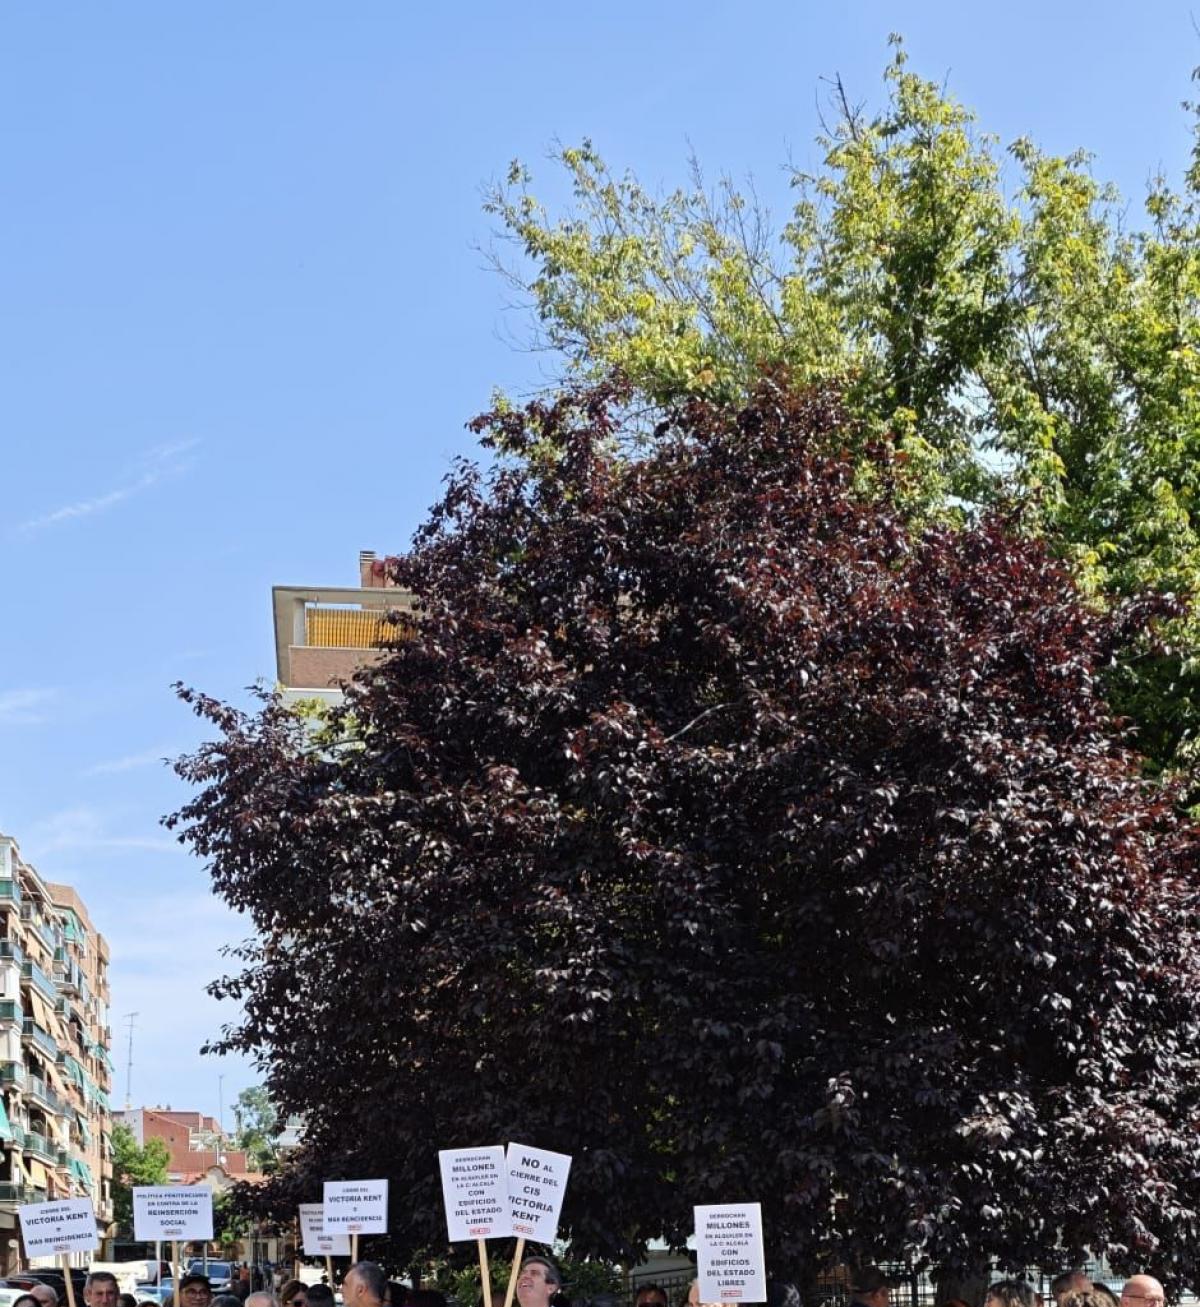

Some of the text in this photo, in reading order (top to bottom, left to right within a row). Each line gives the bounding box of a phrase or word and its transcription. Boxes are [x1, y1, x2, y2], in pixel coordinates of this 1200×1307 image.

[521, 1157, 540, 1169] NO
[452, 1164, 495, 1172] MILLONES
[510, 1170, 559, 1187] CIERRE DEL
[523, 1186, 541, 1196] CIS
[328, 1195, 362, 1203] VICTORIA
[458, 1198, 496, 1207] EDIFICIOS
[148, 1208, 199, 1216] REINSERCIÓN
[472, 1207, 503, 1215] ESTADO
[25, 1212, 88, 1226] VICTORIA KENT
[511, 1210, 541, 1222] KENT
[466, 1217, 494, 1225] LIBRES
[706, 1221, 750, 1229] MILLONES
